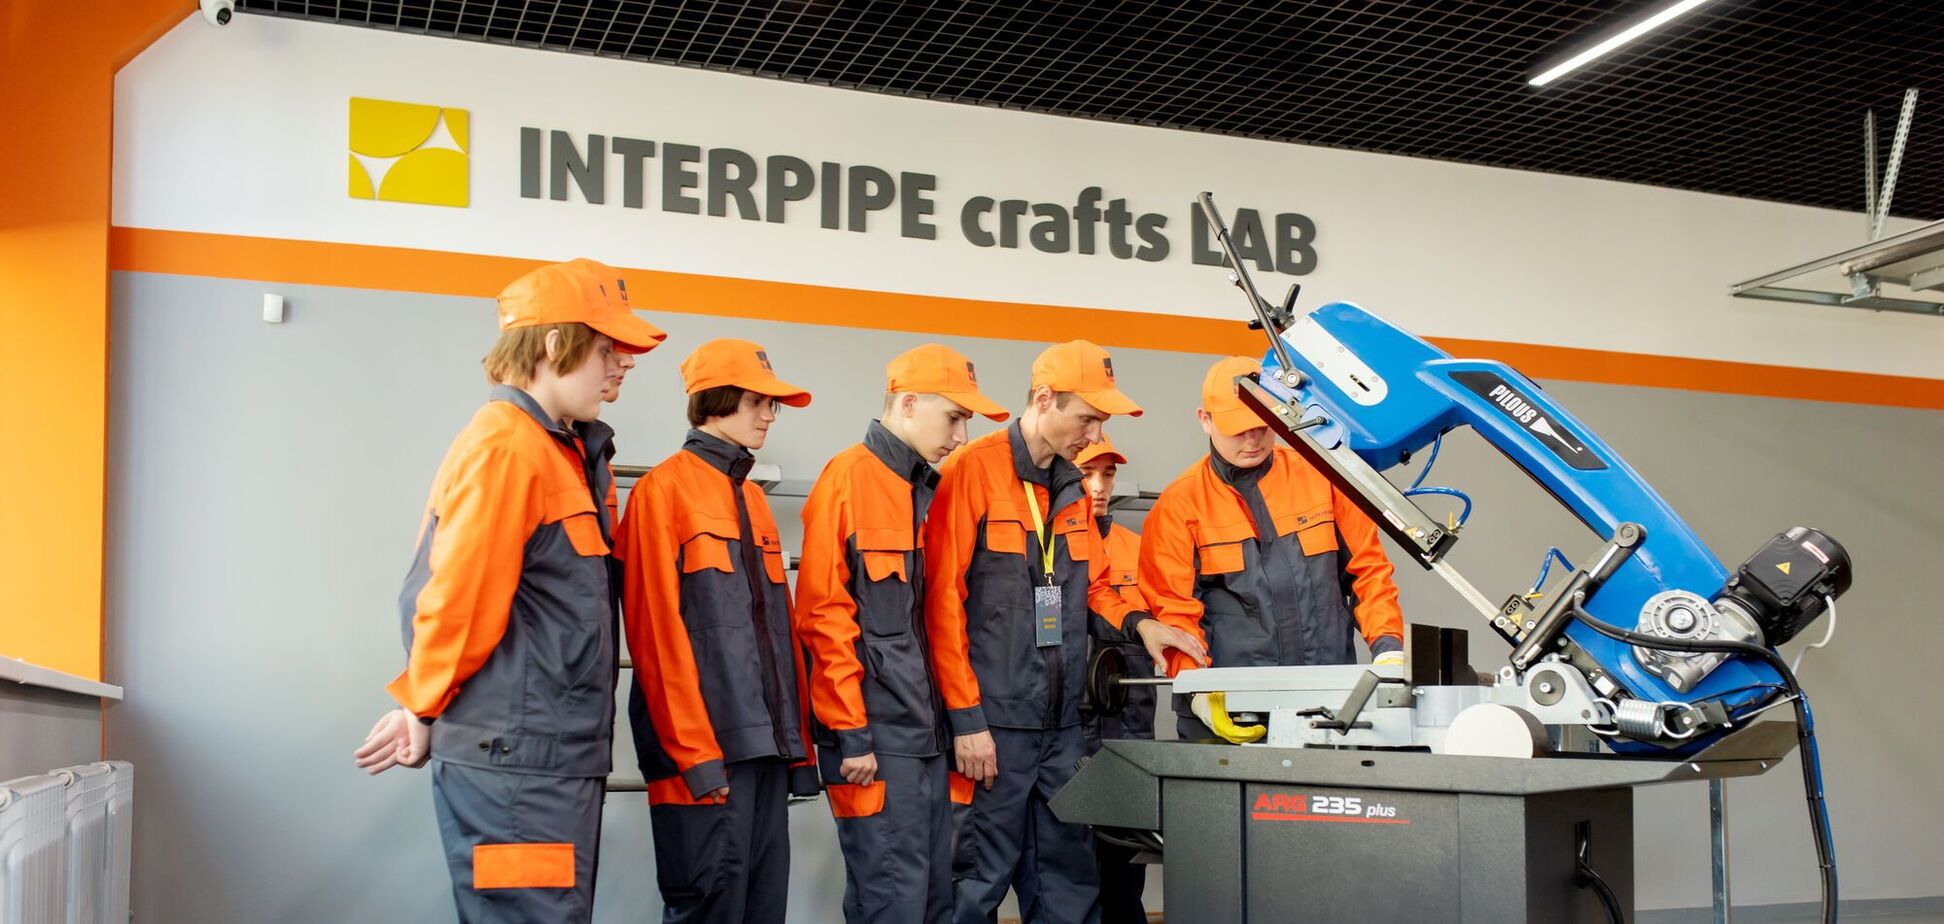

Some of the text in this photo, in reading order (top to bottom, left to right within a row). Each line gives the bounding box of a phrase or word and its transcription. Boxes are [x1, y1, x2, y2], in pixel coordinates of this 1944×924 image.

[520, 126, 1318, 276] INTERPIPE crafts LAB
[1489, 384, 1538, 424] PILOUS
[1253, 793, 1396, 818] ARG 235 plus
